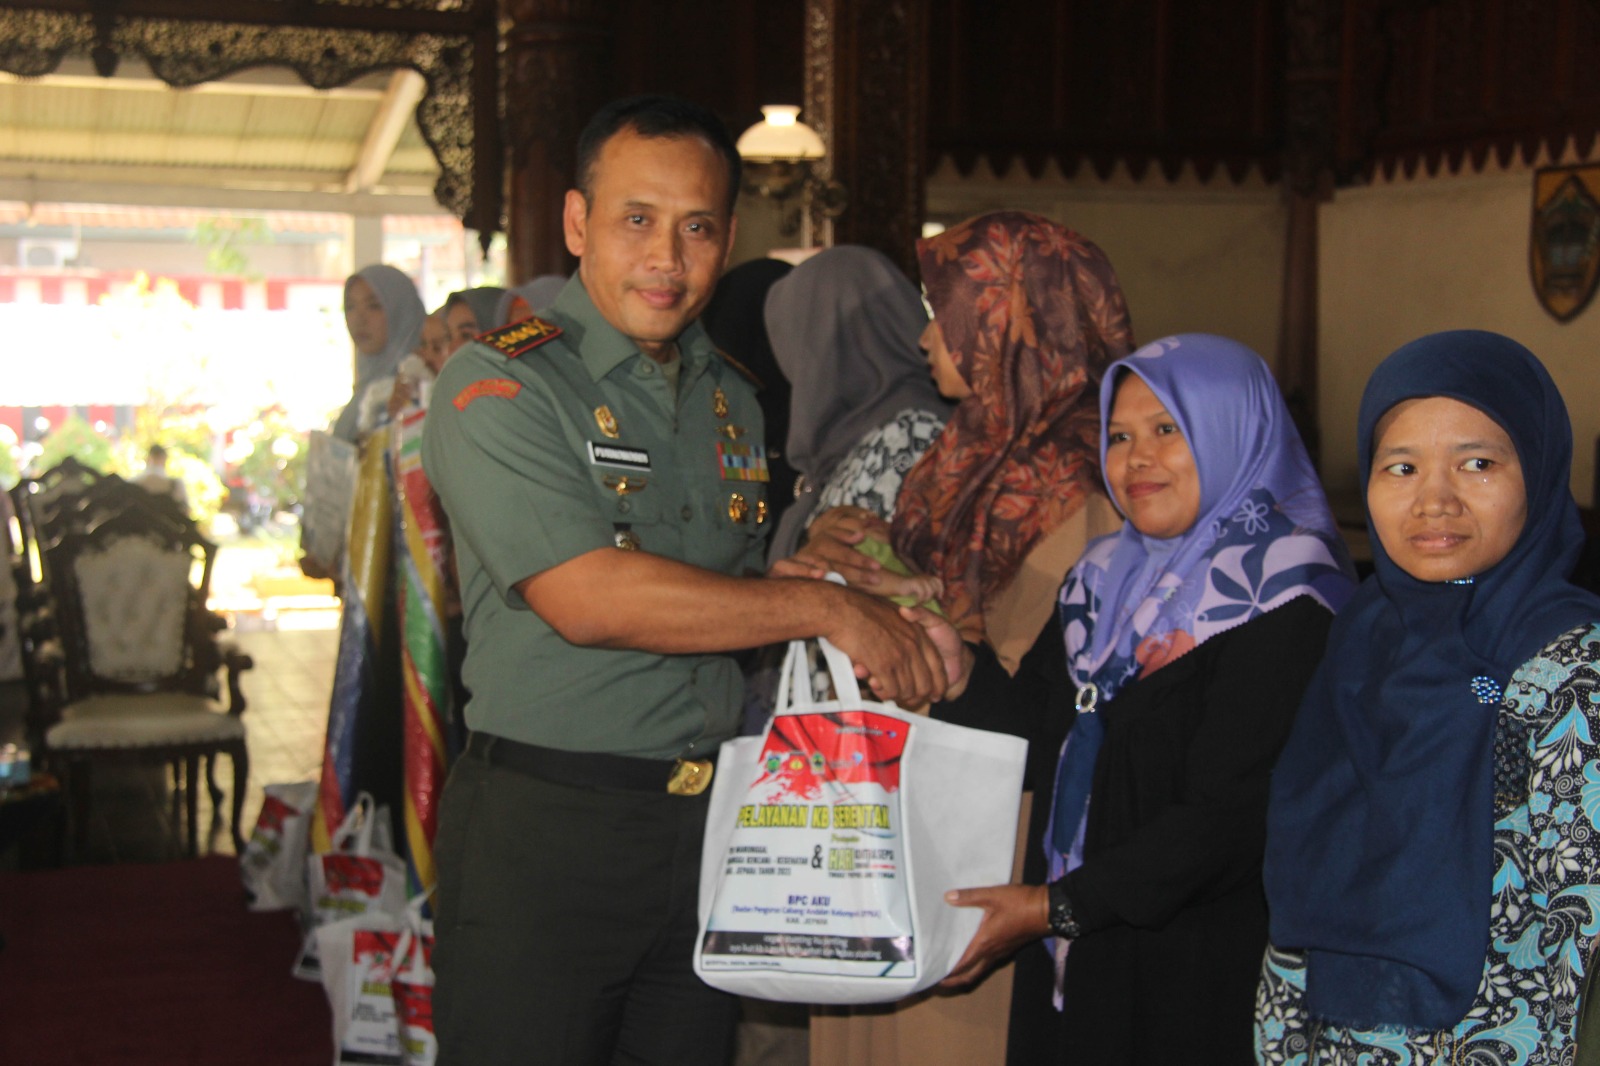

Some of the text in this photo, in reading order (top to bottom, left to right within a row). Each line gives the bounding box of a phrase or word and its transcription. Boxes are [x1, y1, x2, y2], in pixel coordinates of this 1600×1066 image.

[736, 804, 890, 829] PELAYANAN KB SERENTAK
[811, 844, 822, 869] &
[788, 895, 831, 906] BPC AKU
